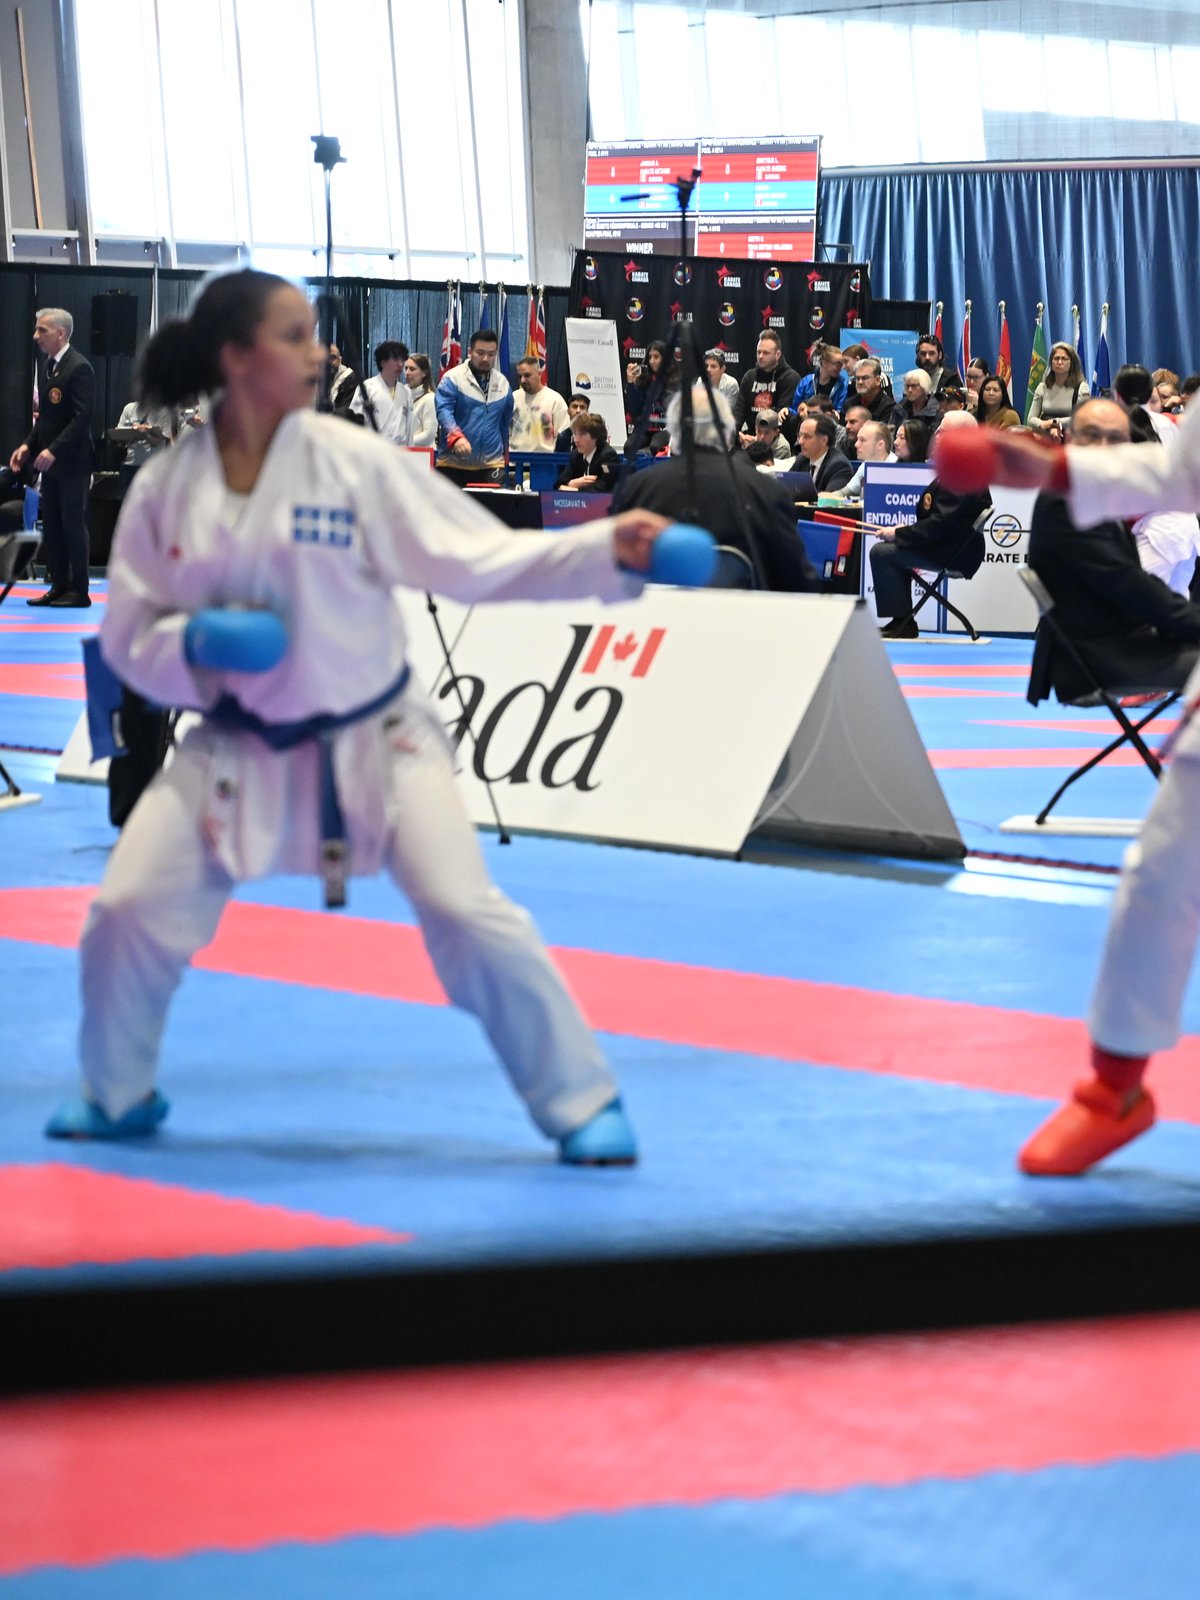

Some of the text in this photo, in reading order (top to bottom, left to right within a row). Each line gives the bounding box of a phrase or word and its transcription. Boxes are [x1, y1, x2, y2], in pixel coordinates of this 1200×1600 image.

[626, 243, 653, 254] WINNER
[885, 493, 920, 506] COACH
[866, 511, 917, 526] ENTRAÎNE
[983, 553, 1020, 563] RATE
[439, 624, 623, 791] ada
